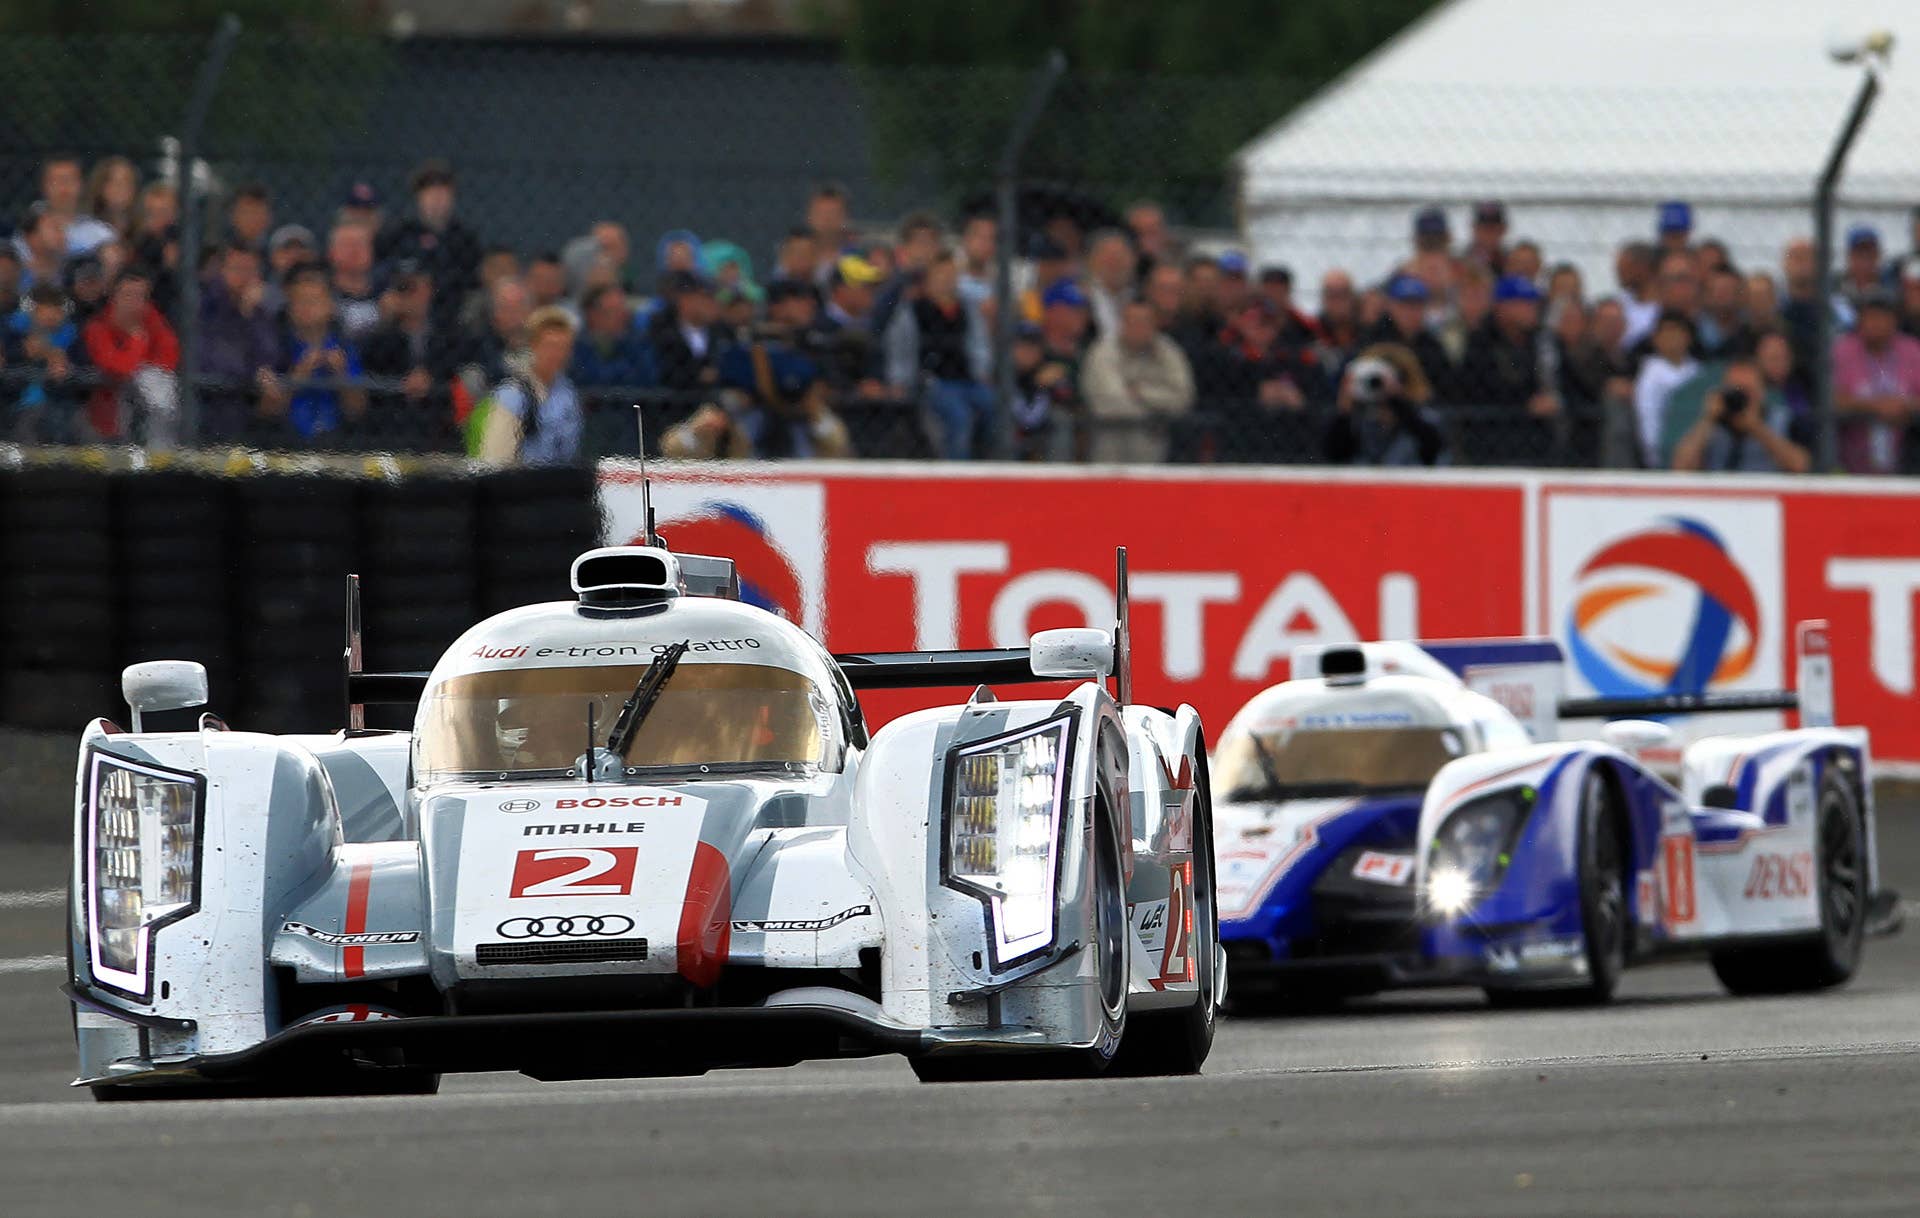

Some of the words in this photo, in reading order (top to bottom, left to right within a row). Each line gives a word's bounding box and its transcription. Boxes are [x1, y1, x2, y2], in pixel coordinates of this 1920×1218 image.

[472, 644, 530, 660] Audi
[535, 645, 638, 658] e-tron
[650, 636, 761, 656] qattro
[555, 796, 683, 810] BOSCH
[523, 822, 646, 836] MAHLE
[521, 848, 623, 896] 2
[763, 904, 867, 930] MICHELIN
[1166, 870, 1184, 974] 2
[311, 931, 416, 944] MICHELIN
